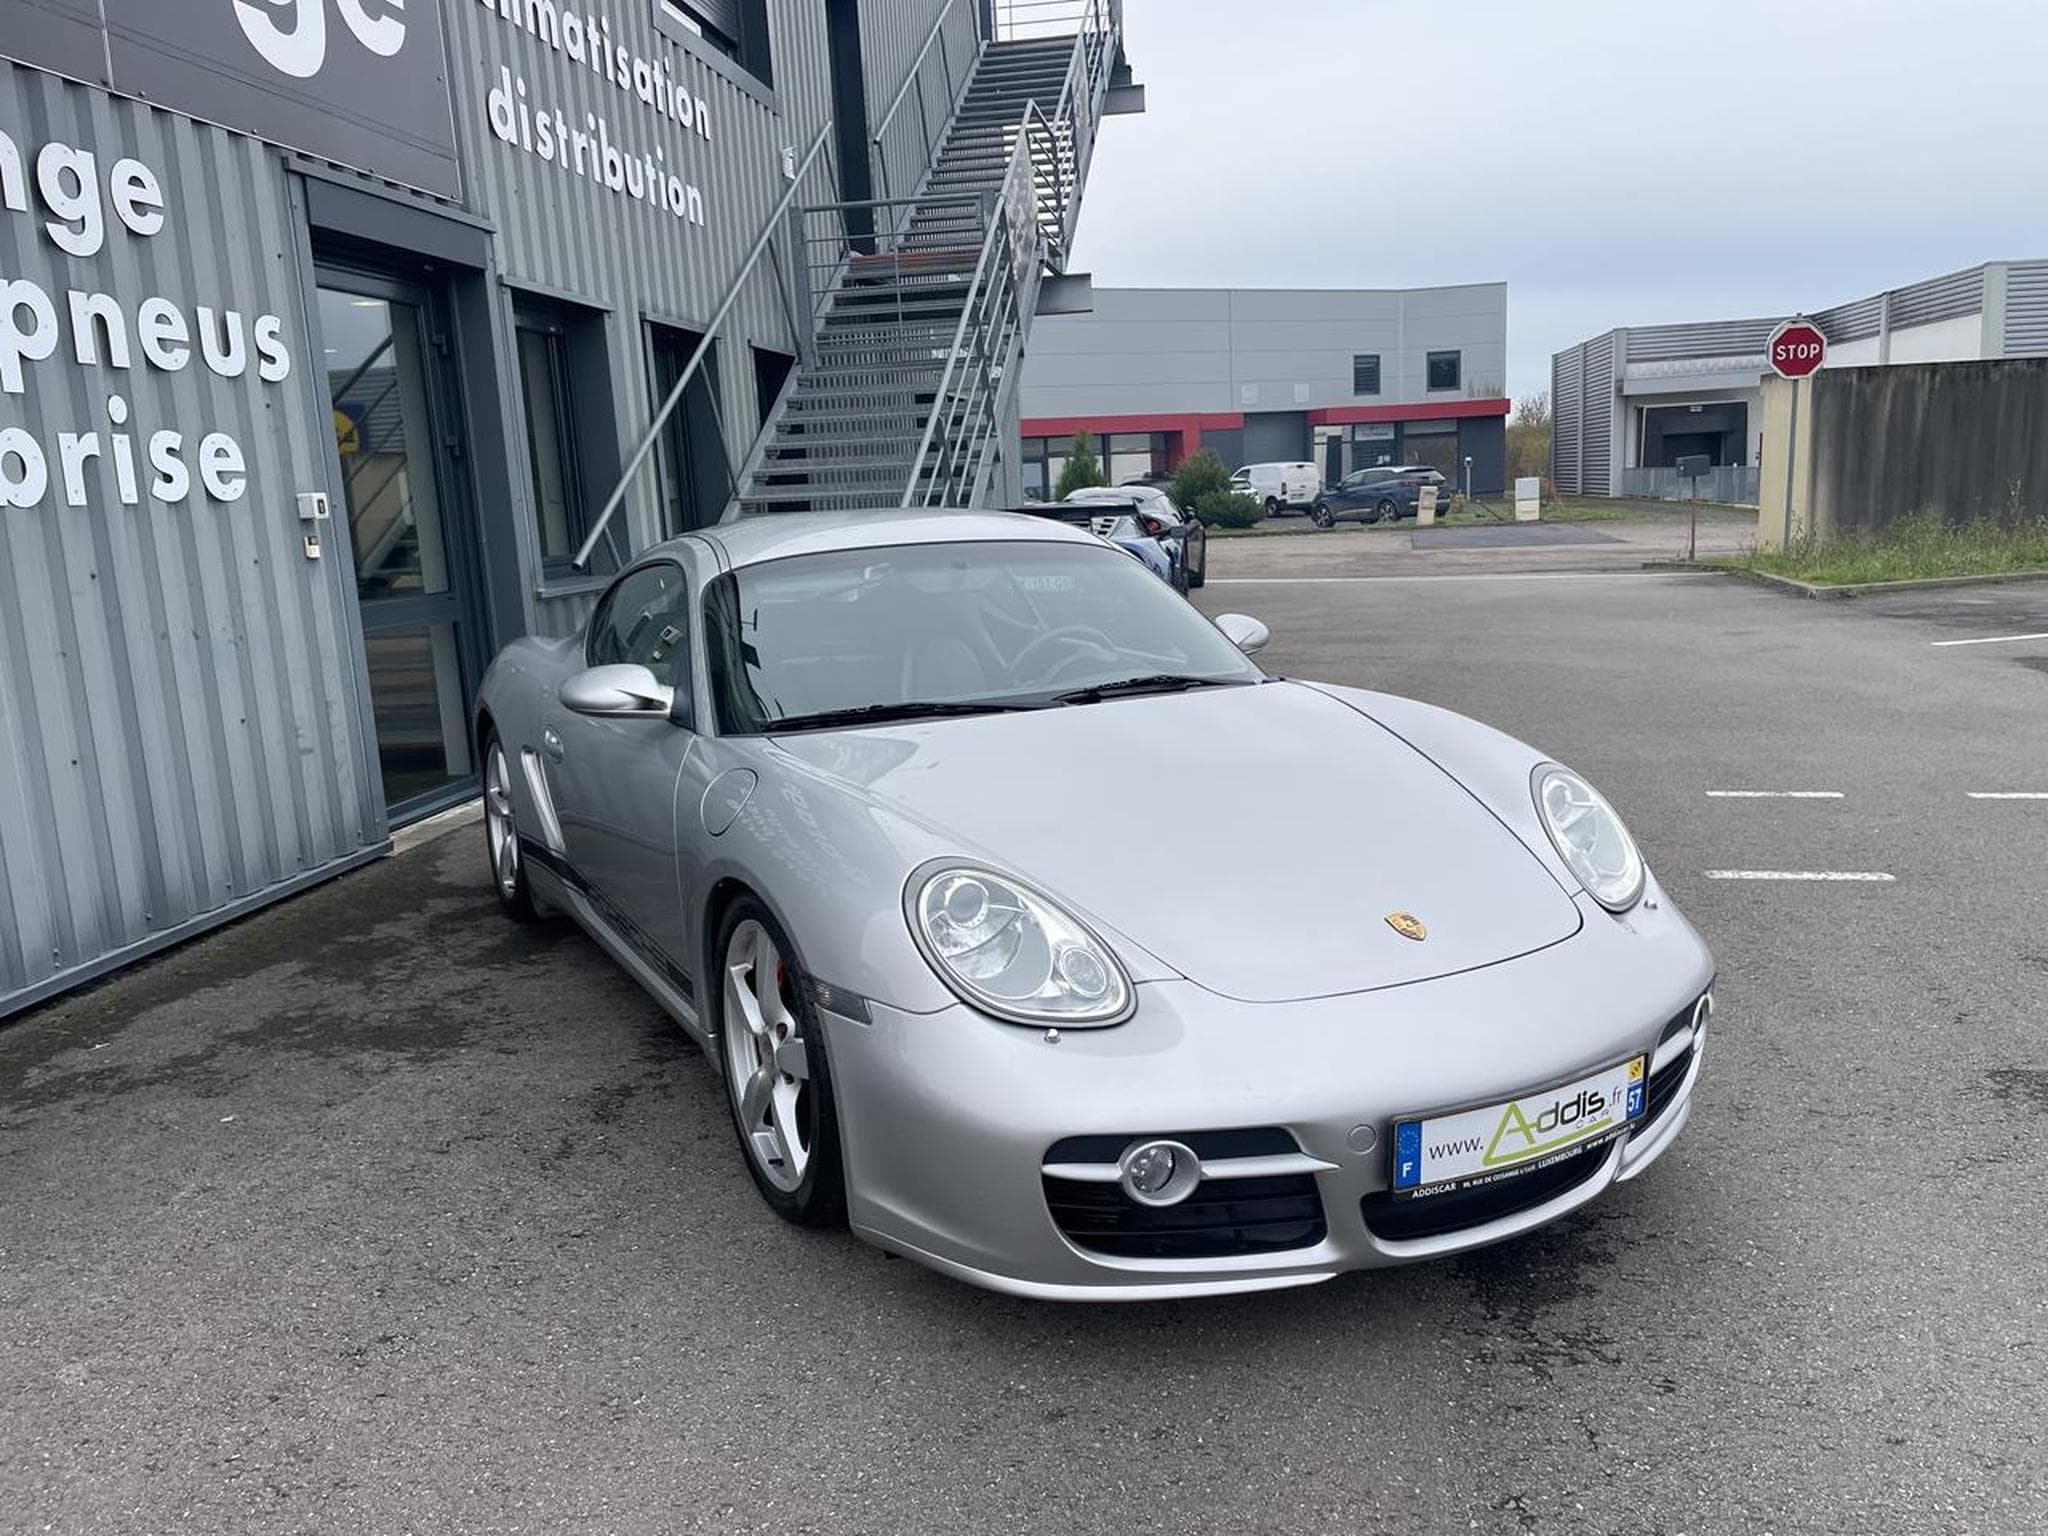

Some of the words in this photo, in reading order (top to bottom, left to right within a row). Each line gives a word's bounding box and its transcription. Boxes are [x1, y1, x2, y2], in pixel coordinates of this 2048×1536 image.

[480, 0, 711, 140] matisation
[489, 65, 704, 226] distribution
[0, 279, 290, 393] pneus
[1776, 343, 1820, 361] STOP
[1628, 1087, 1642, 1112] 57
[1402, 1162, 1413, 1178] F
[1412, 1182, 1457, 1199] ADDISCAR
